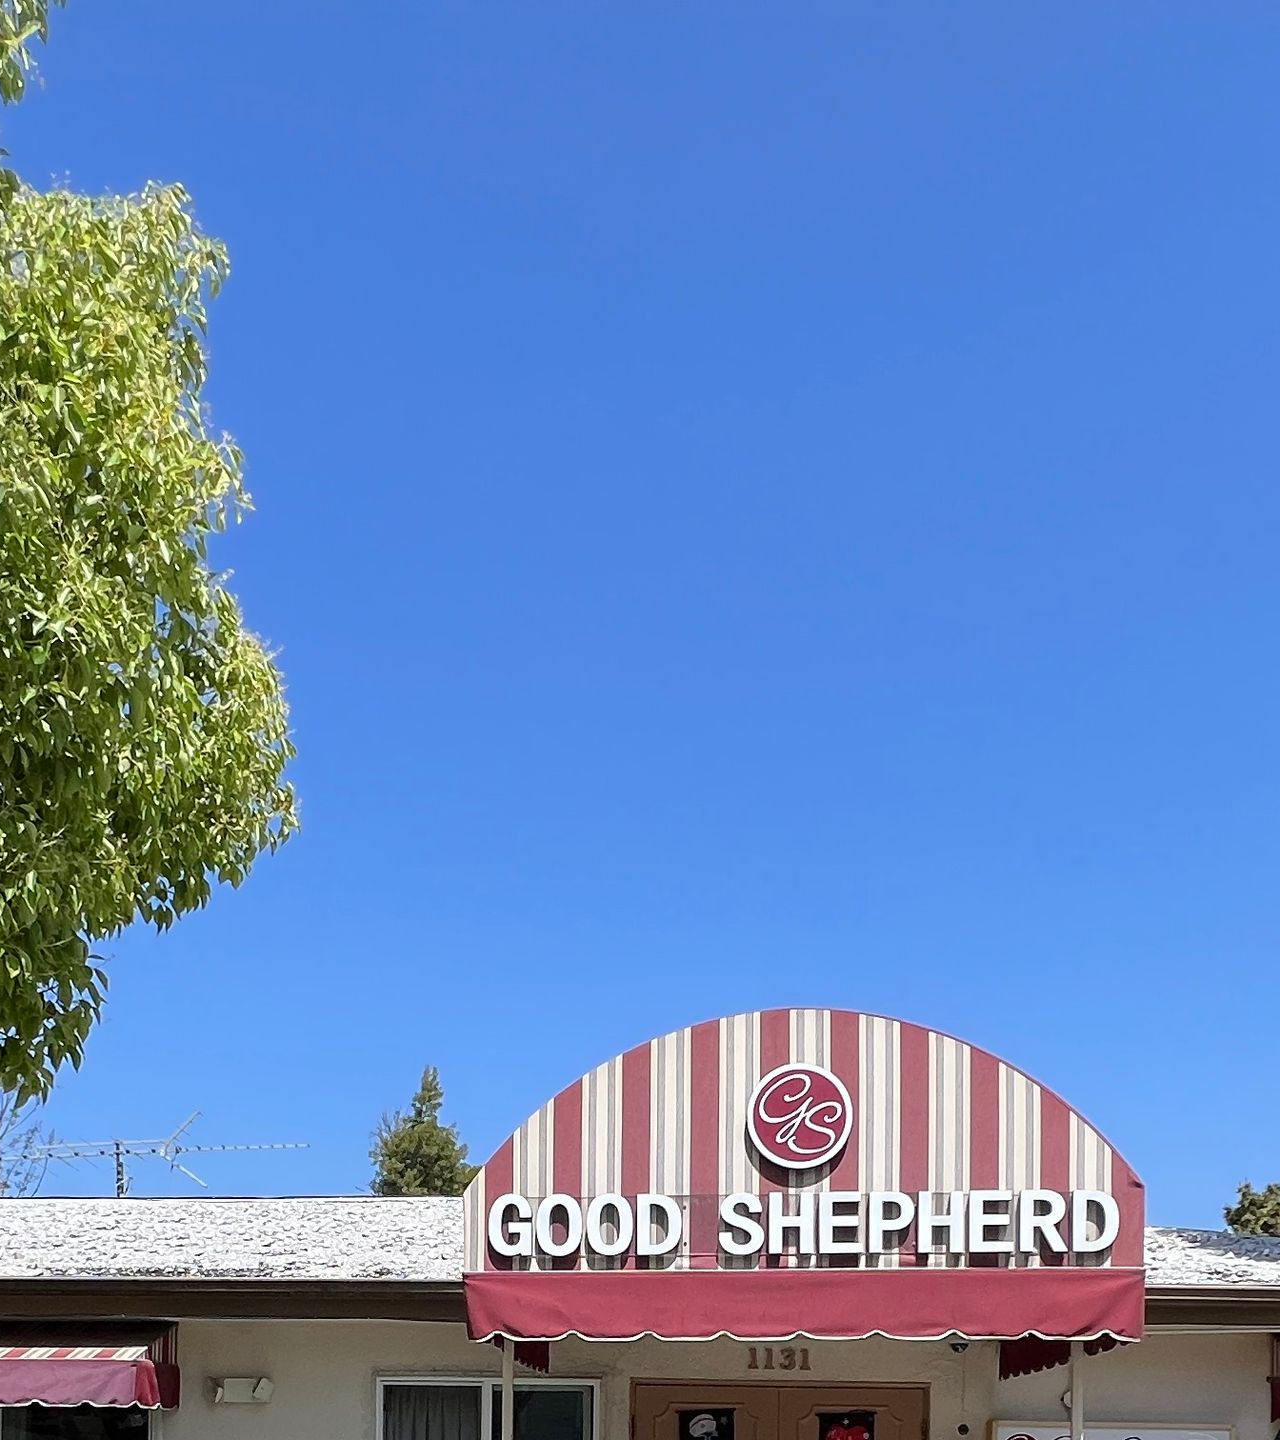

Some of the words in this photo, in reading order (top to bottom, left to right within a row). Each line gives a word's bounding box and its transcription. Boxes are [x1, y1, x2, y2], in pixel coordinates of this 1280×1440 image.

[488, 1193, 683, 1257] GOOD
[719, 1189, 1120, 1256] SHEPHERD
[748, 1347, 812, 1371] 1131
